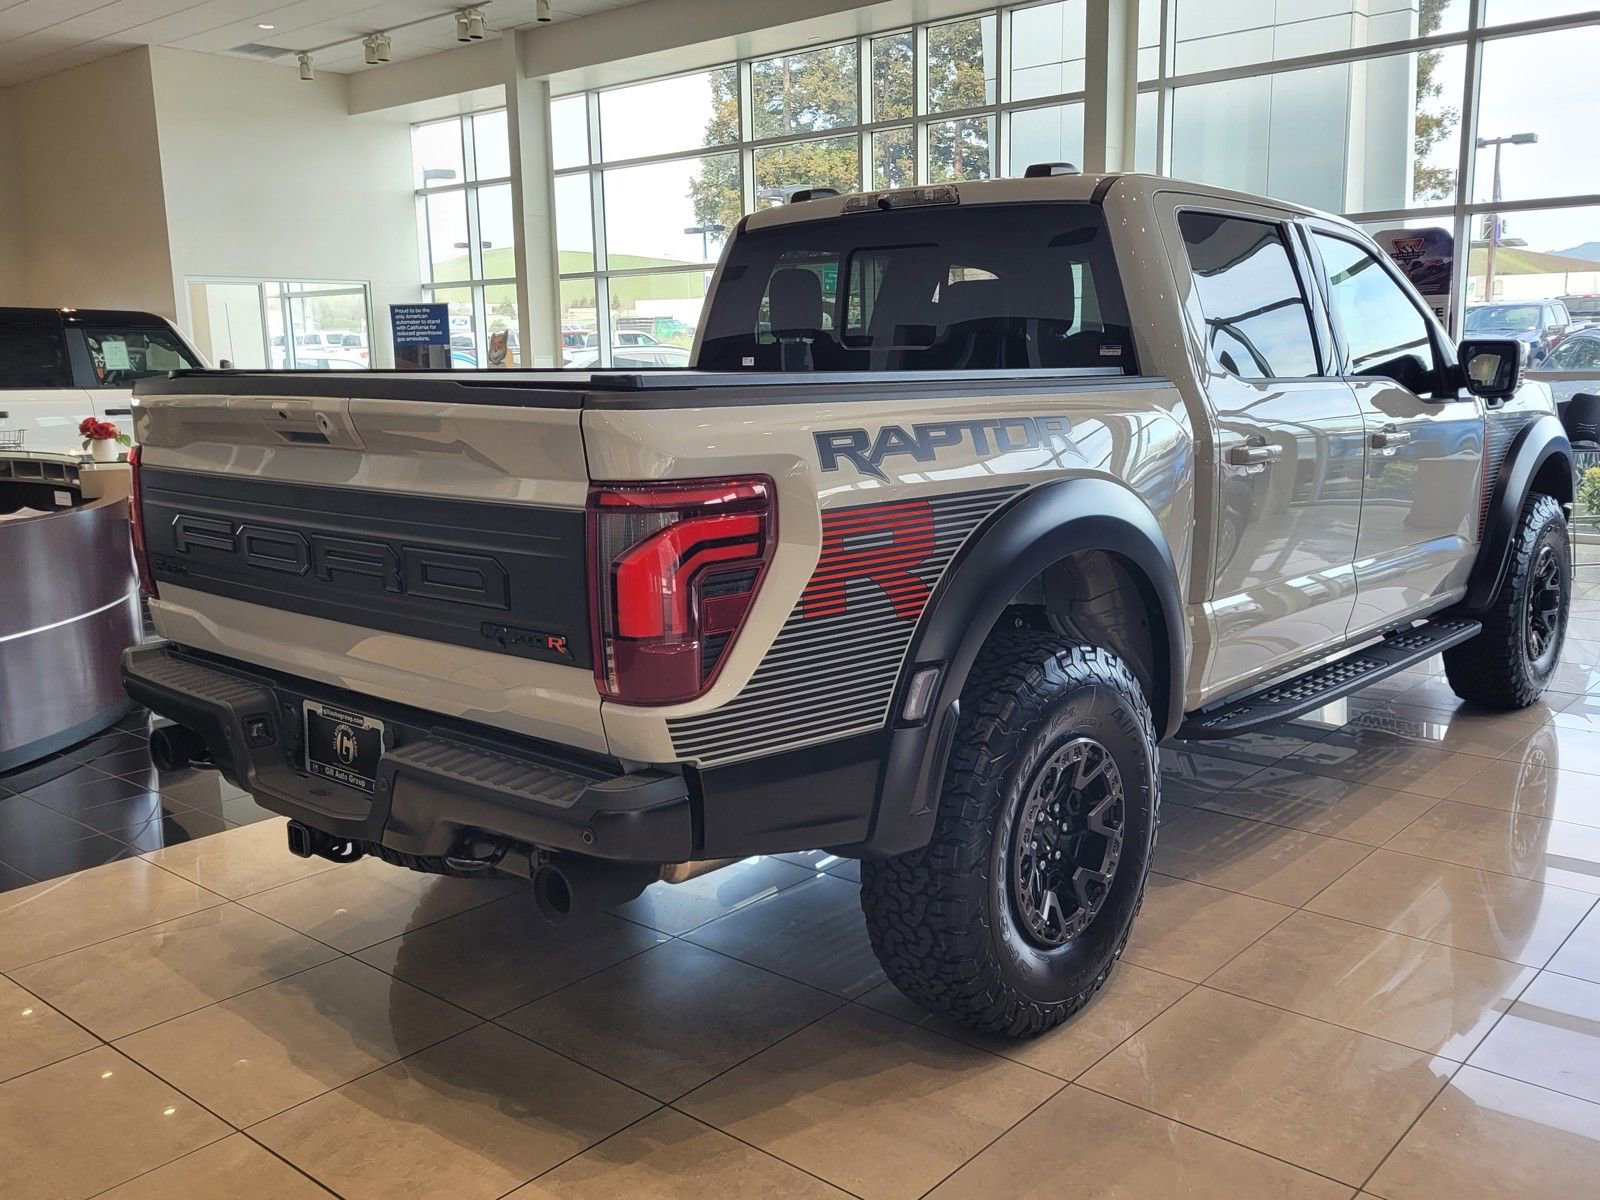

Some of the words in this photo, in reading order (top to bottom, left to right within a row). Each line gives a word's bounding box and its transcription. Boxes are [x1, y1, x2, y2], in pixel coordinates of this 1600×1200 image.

[812, 416, 1089, 484] RAPTOR
[171, 513, 511, 611] FORD
[325, 766, 334, 776] Gill
[335, 770, 348, 780] Auto
[348, 774, 366, 788] Group
